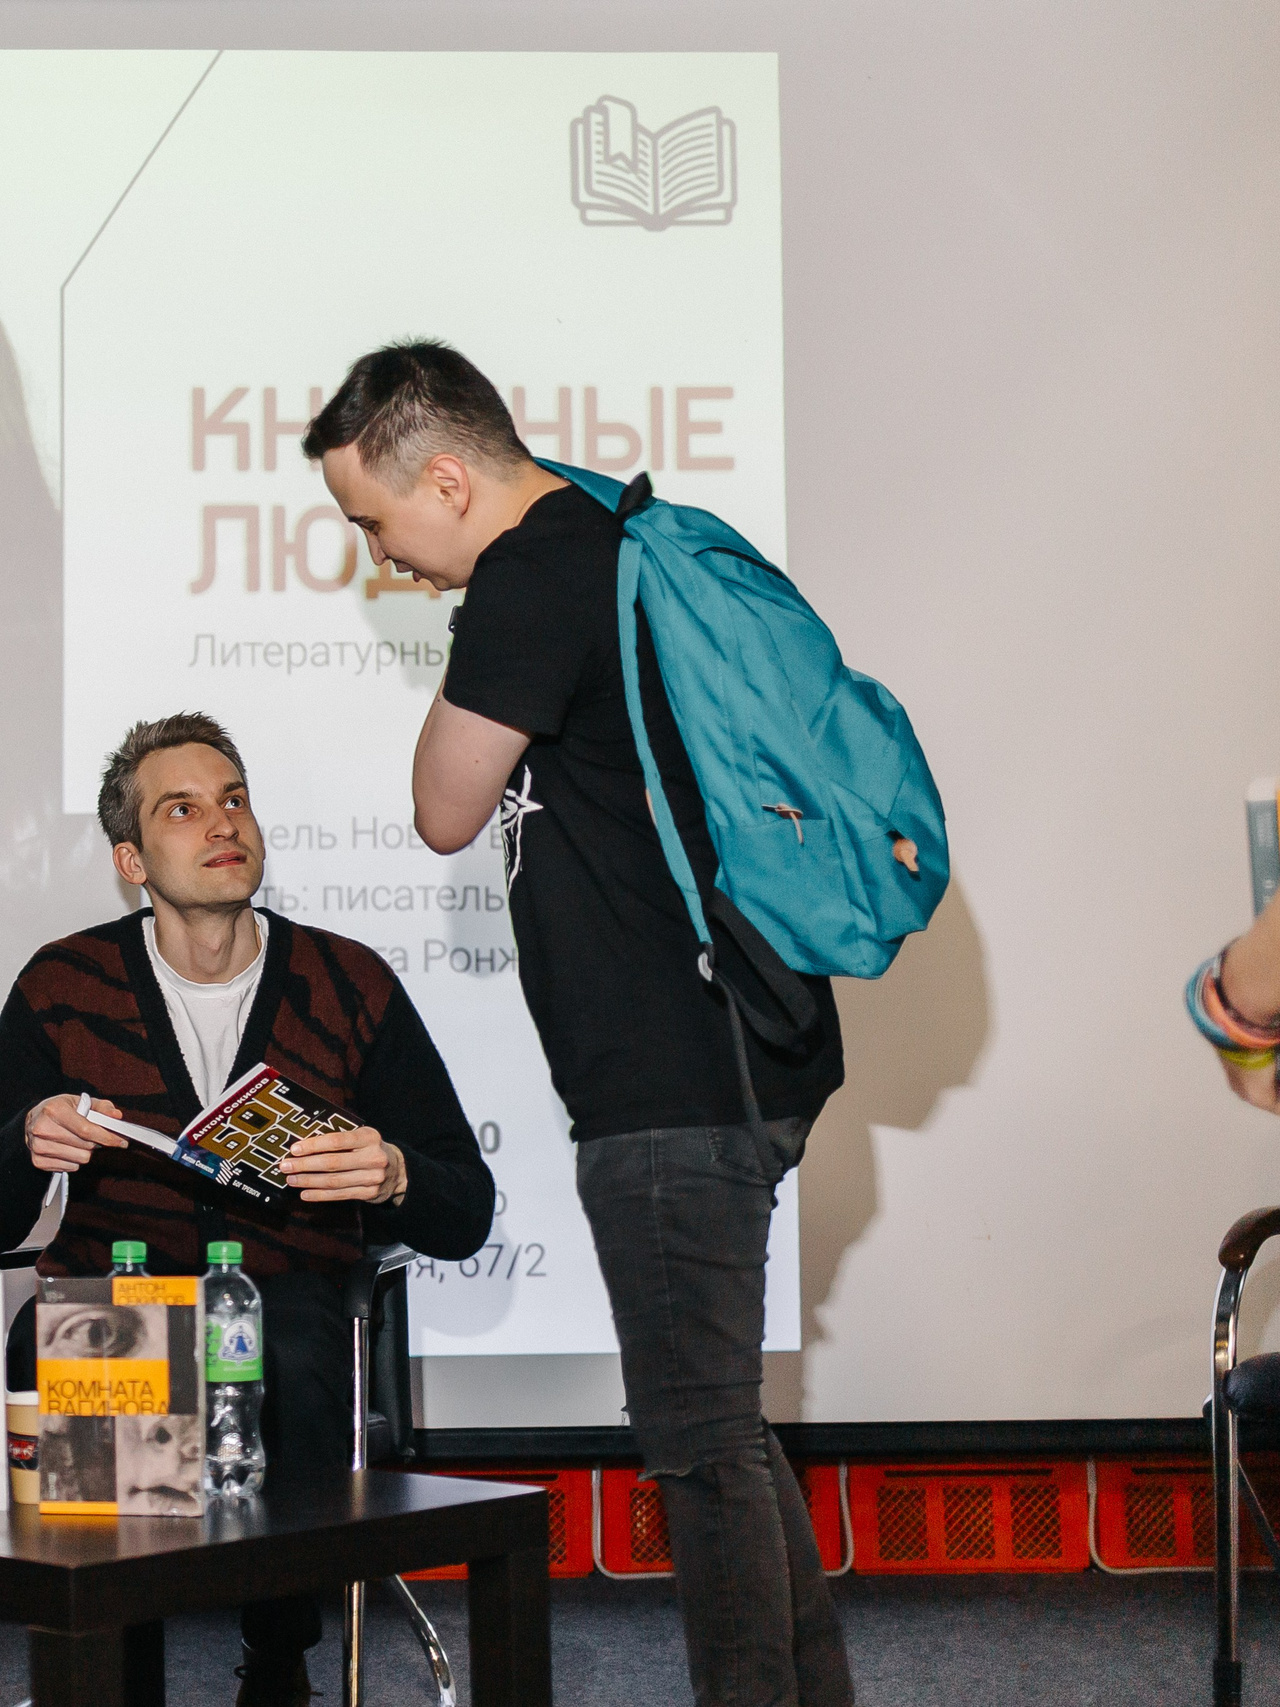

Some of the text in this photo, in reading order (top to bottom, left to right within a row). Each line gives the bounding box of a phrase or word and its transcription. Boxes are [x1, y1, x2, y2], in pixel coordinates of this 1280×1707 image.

[190, 386, 736, 472] КННЫЕ
[188, 634, 451, 675] Литературны
[196, 1079, 304, 1161] БОГ
[47, 1380, 154, 1399] КОМНАТА
[47, 1400, 169, 1416] ВАГИНОВА
